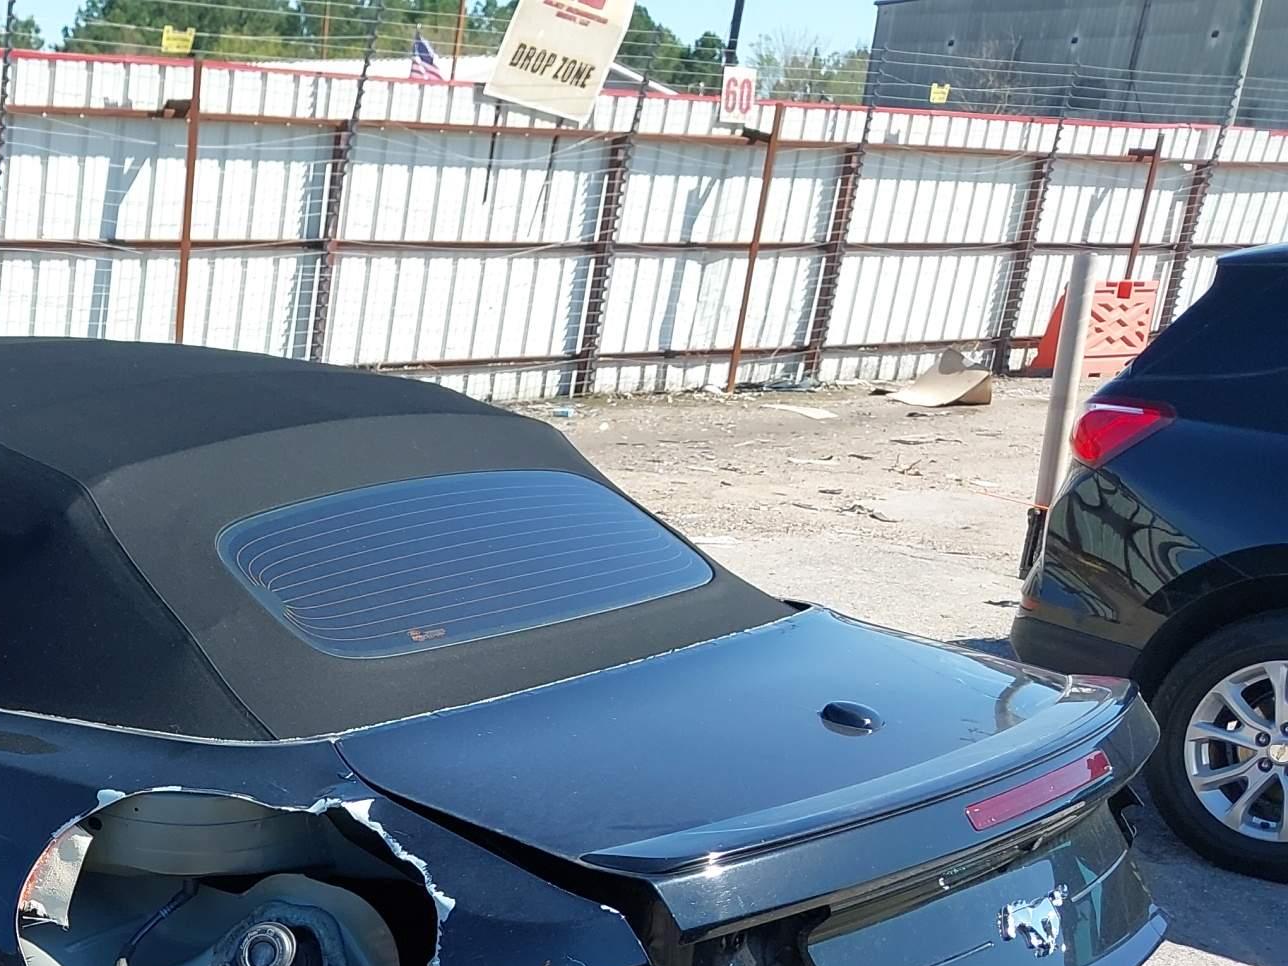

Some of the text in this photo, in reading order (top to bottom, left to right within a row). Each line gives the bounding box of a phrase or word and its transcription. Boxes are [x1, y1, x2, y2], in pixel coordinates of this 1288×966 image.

[508, 42, 596, 88] DROP ZONE
[725, 77, 752, 114] 60
